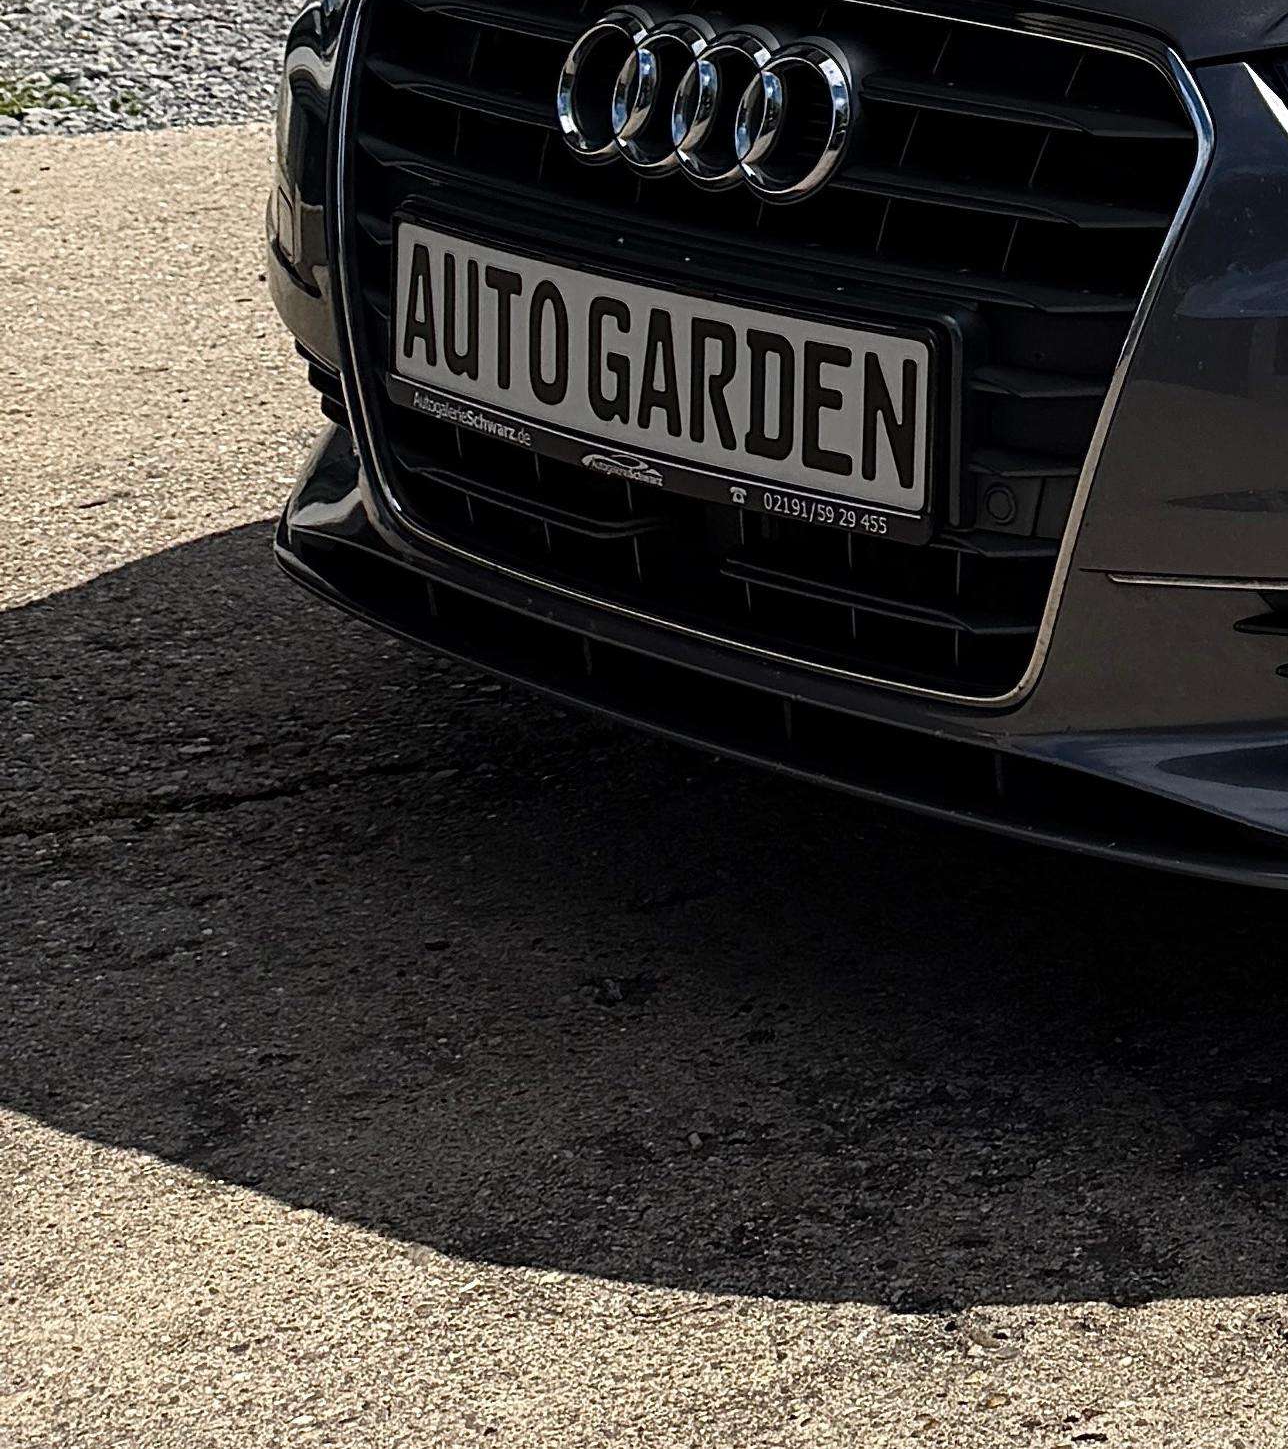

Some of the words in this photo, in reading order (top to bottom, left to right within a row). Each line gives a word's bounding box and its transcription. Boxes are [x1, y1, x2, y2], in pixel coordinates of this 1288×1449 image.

[403, 242, 569, 406] AUTO
[588, 295, 918, 490] GARDEN
[413, 390, 532, 447] AutogalerieSchwarz.de
[763, 492, 835, 524] 02191/59
[838, 507, 857, 529] 29
[860, 513, 888, 535] 455
